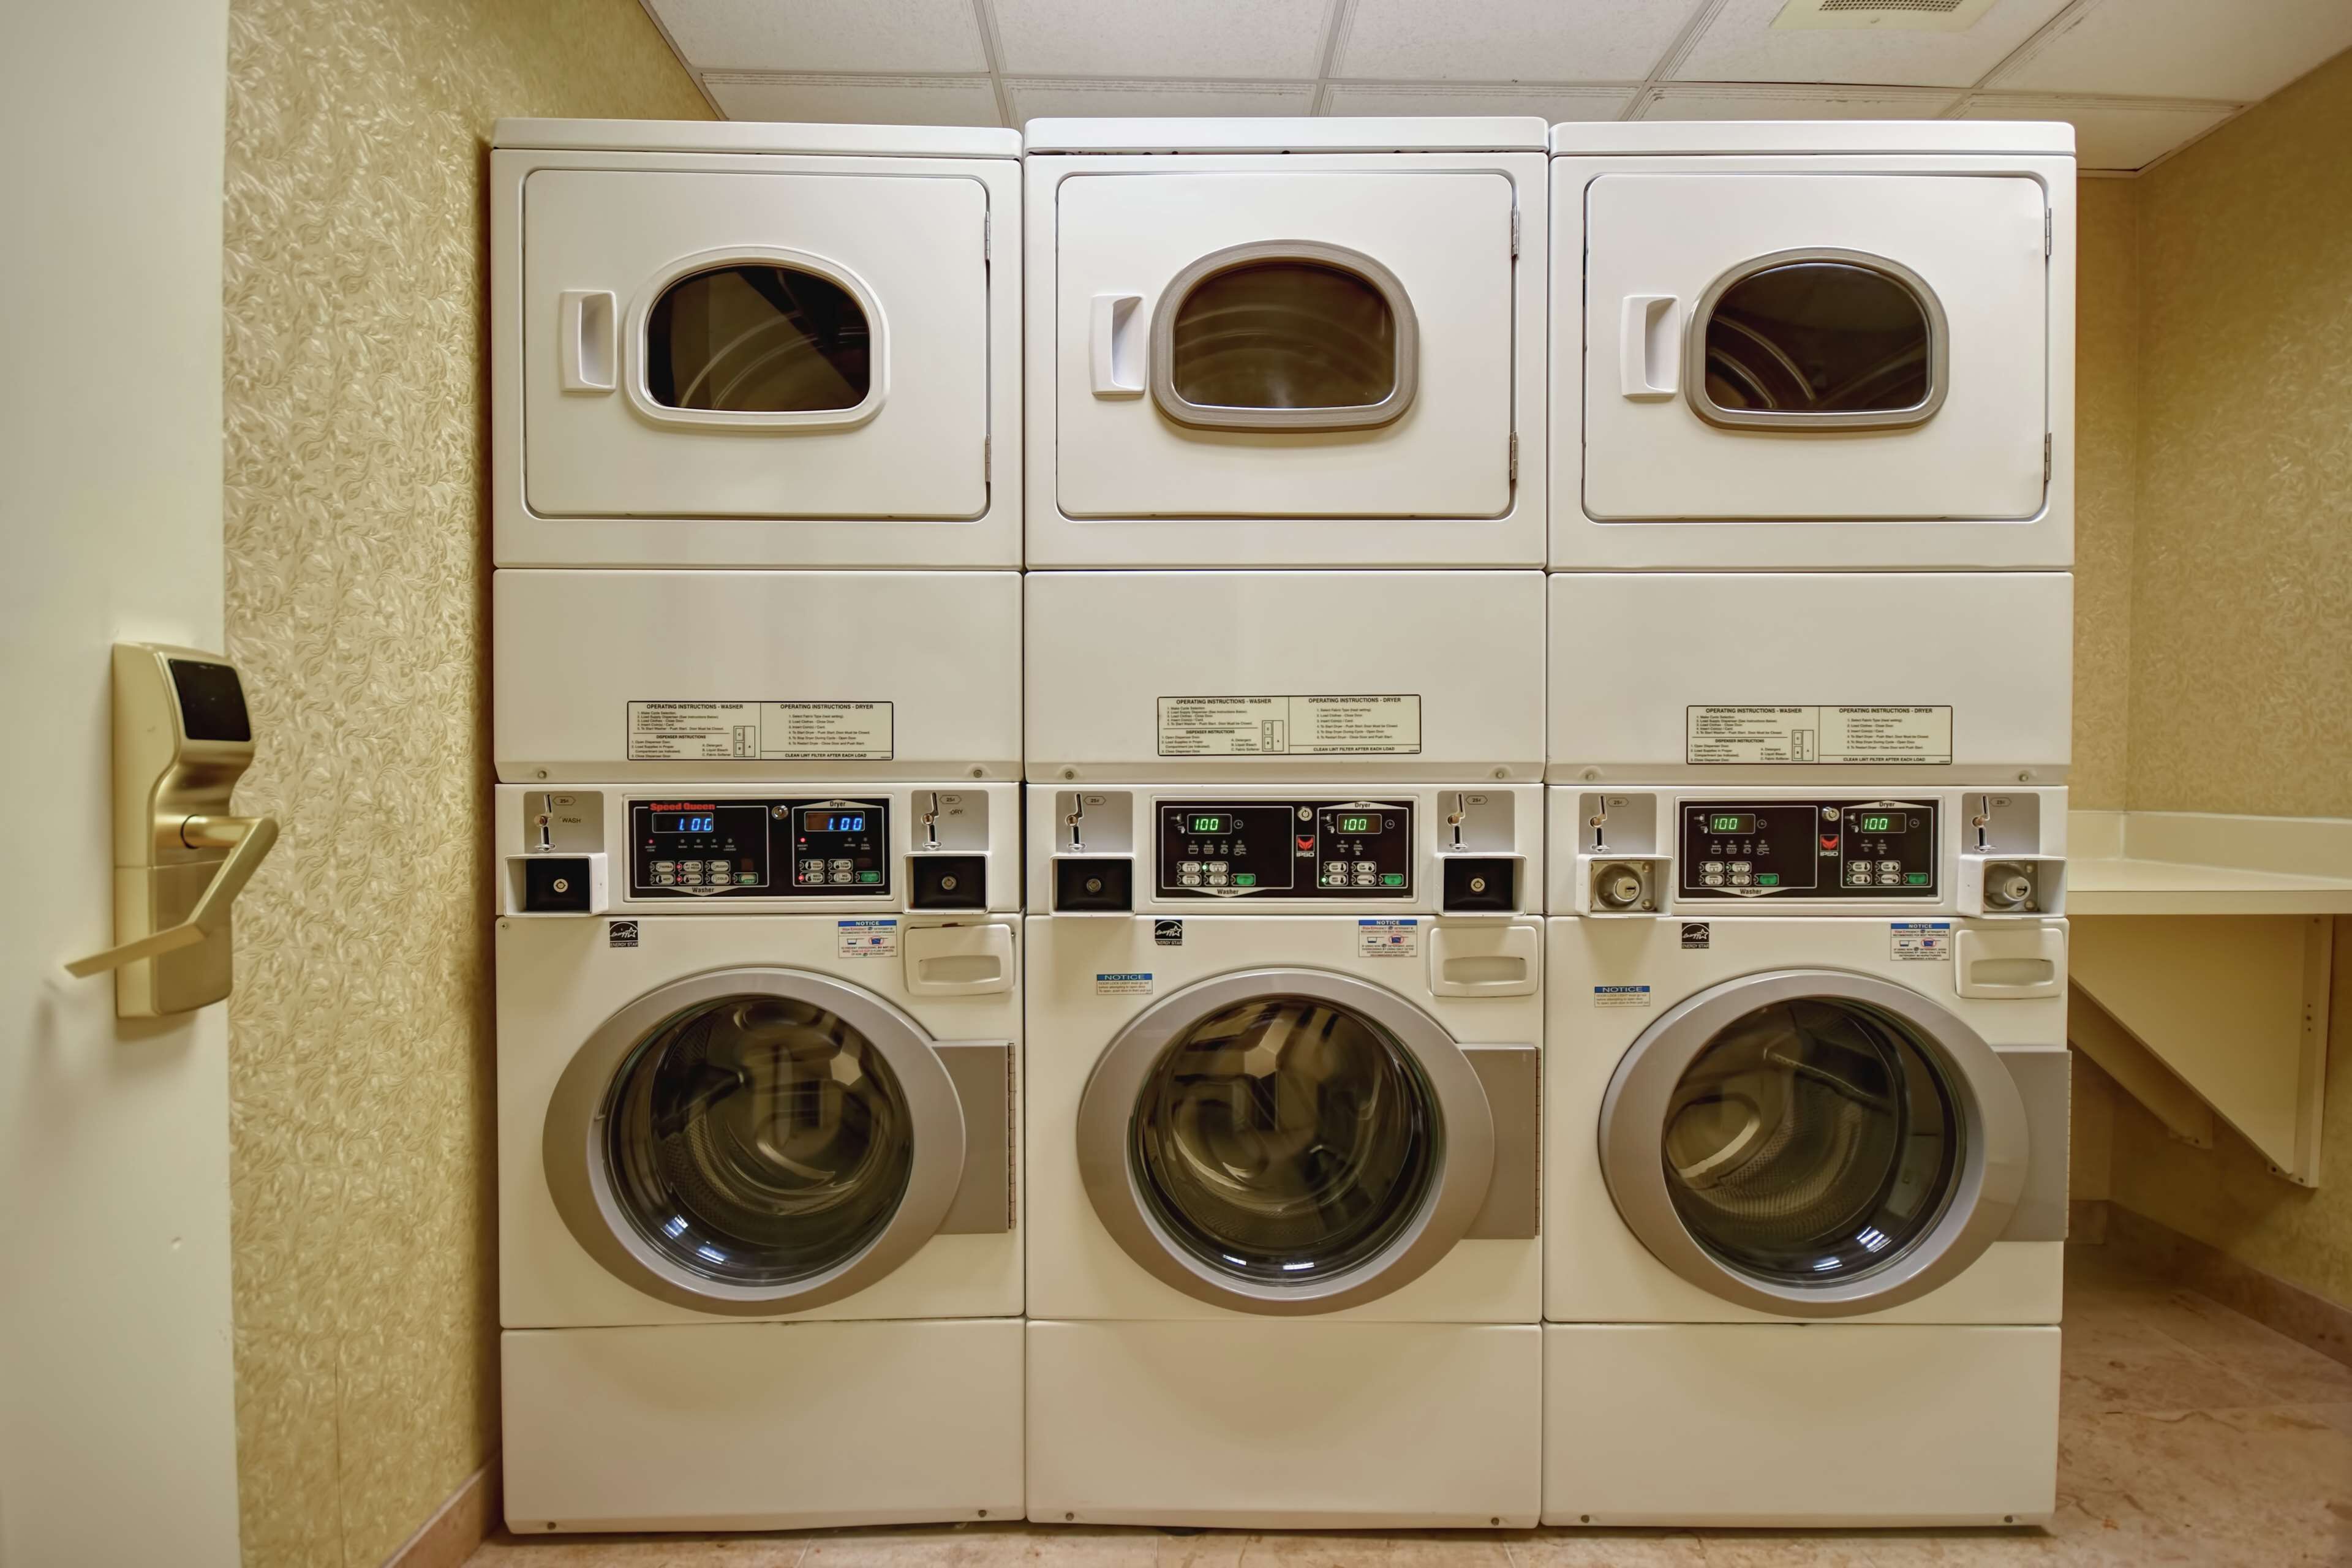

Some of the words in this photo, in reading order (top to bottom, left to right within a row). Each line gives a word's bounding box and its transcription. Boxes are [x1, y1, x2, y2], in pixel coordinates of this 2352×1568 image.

[650, 803, 682, 812] Speed
[1196, 818, 1218, 831] 100
[1344, 819, 1366, 831] 100
[1714, 818, 1738, 829] 100
[1864, 818, 1888, 830] 100
